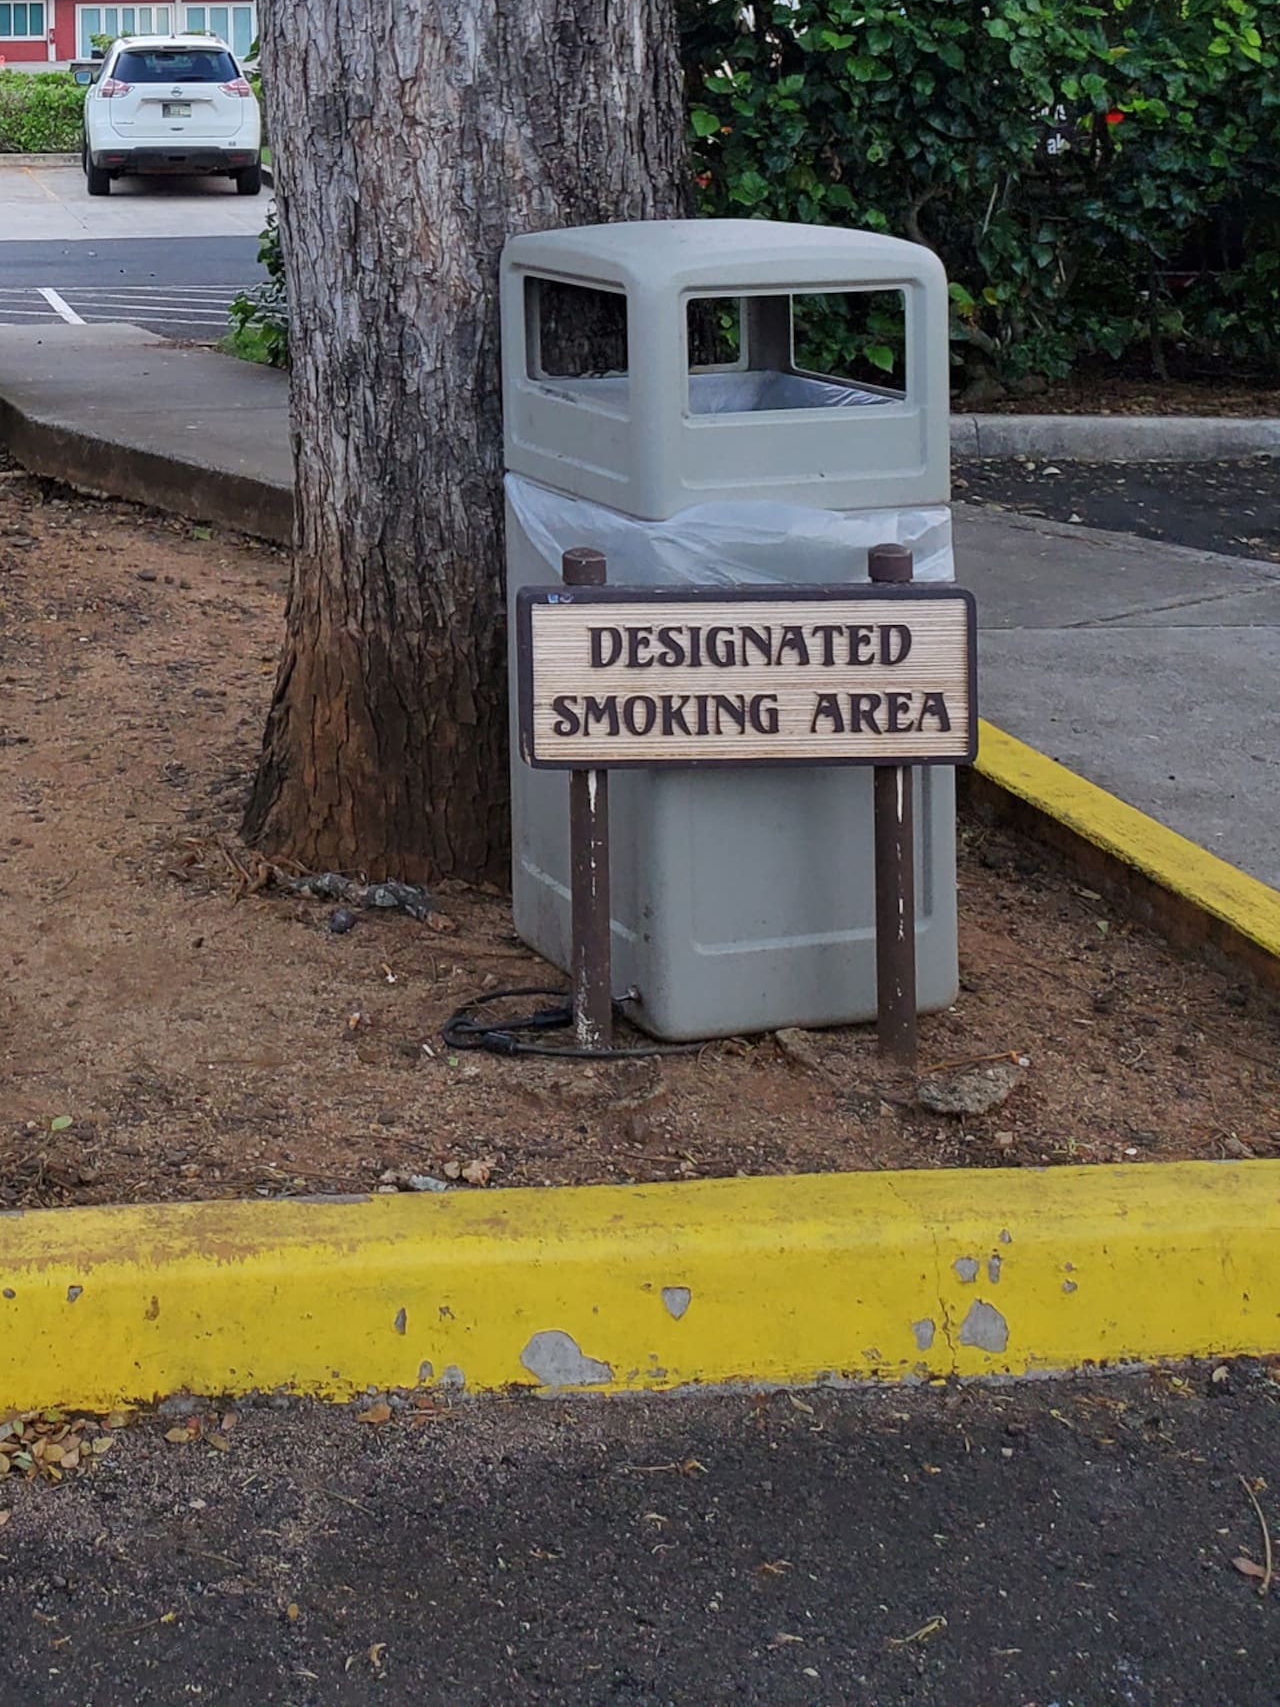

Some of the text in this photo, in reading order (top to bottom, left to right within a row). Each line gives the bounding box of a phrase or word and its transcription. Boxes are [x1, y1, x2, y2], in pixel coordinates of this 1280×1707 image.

[586, 623, 913, 669] DESIGNATED
[551, 691, 952, 737] SMOKING AREA
